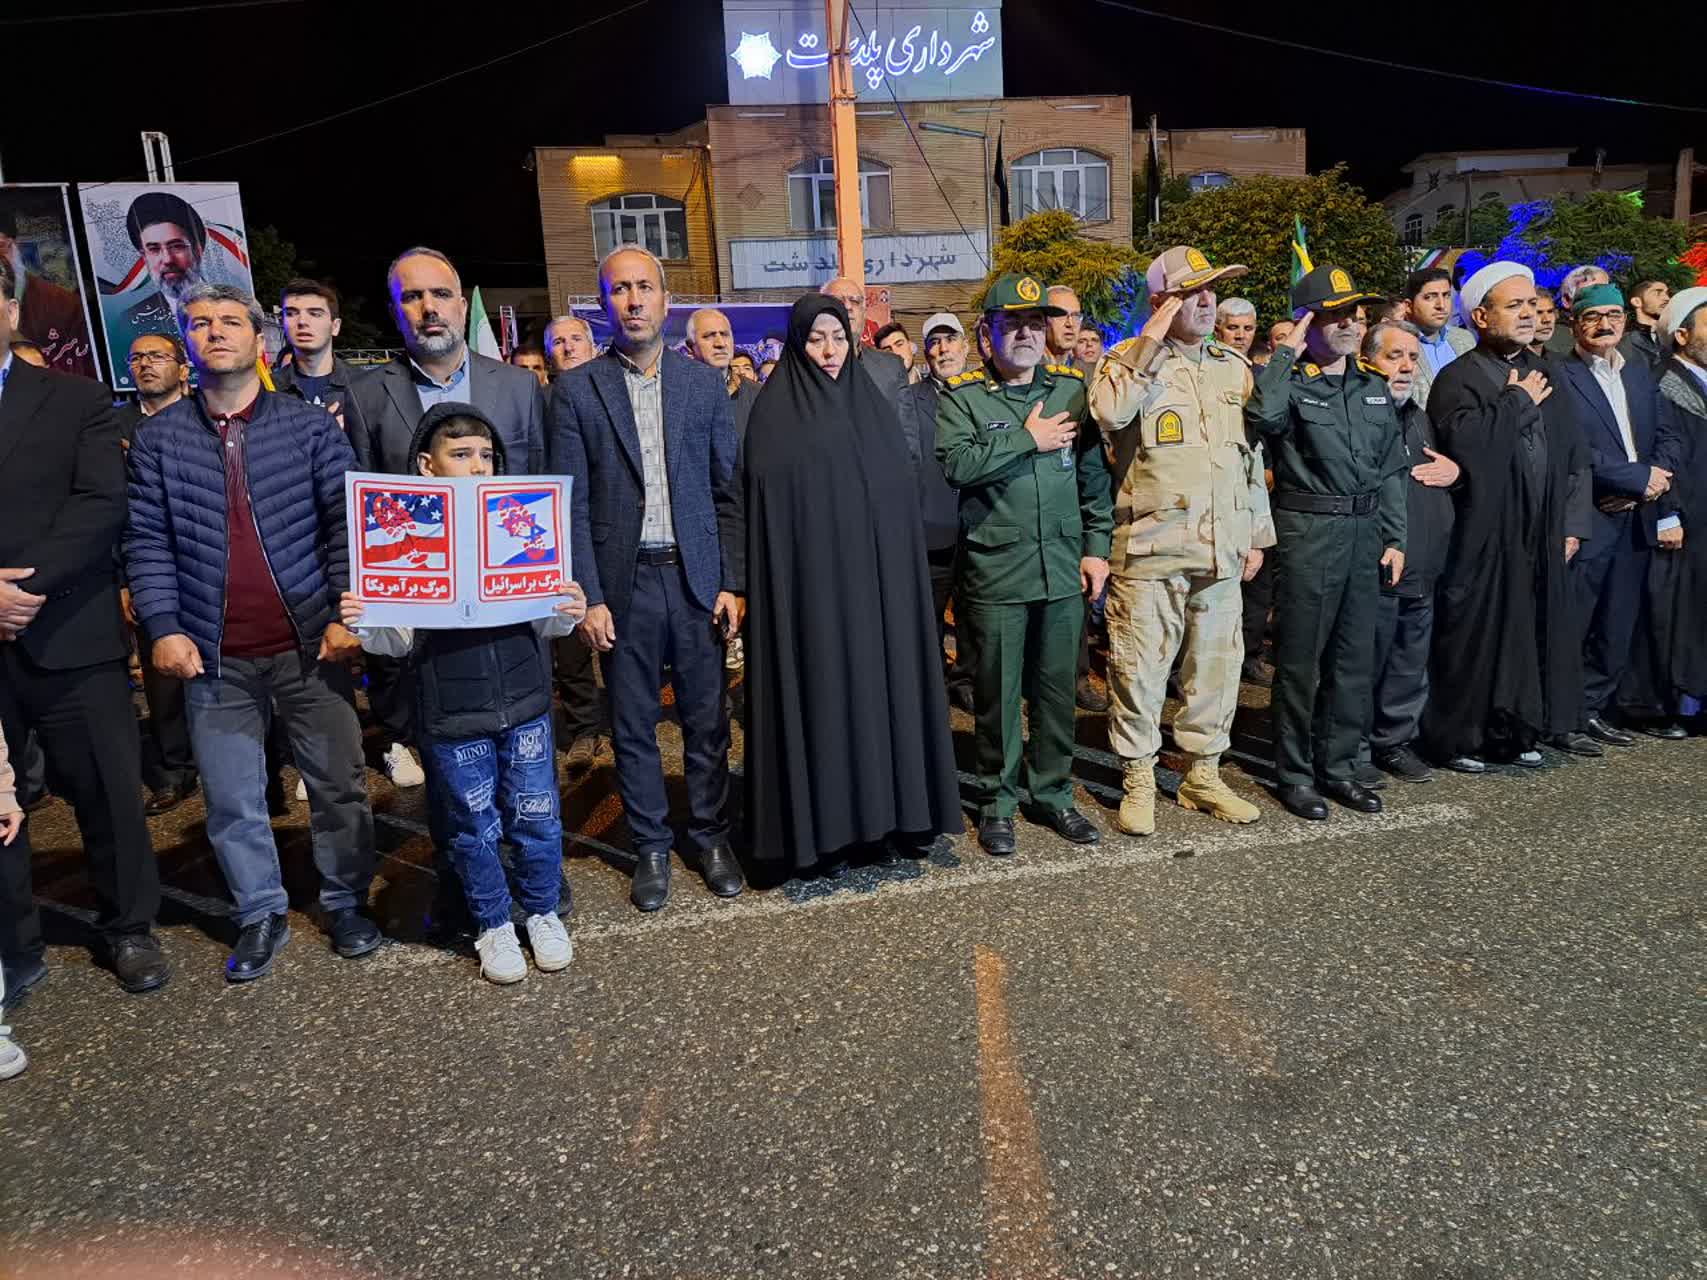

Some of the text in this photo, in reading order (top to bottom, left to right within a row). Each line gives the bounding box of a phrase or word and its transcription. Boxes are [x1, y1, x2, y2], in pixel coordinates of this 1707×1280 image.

[786, 11, 995, 90] شهرداری پلدت
[763, 244, 955, 276] شهرداری لدشت
[365, 577, 448, 597] مرگ بر آمریکا
[485, 573, 561, 595] مرگ بر اسرائیل
[456, 743, 488, 762] MIND
